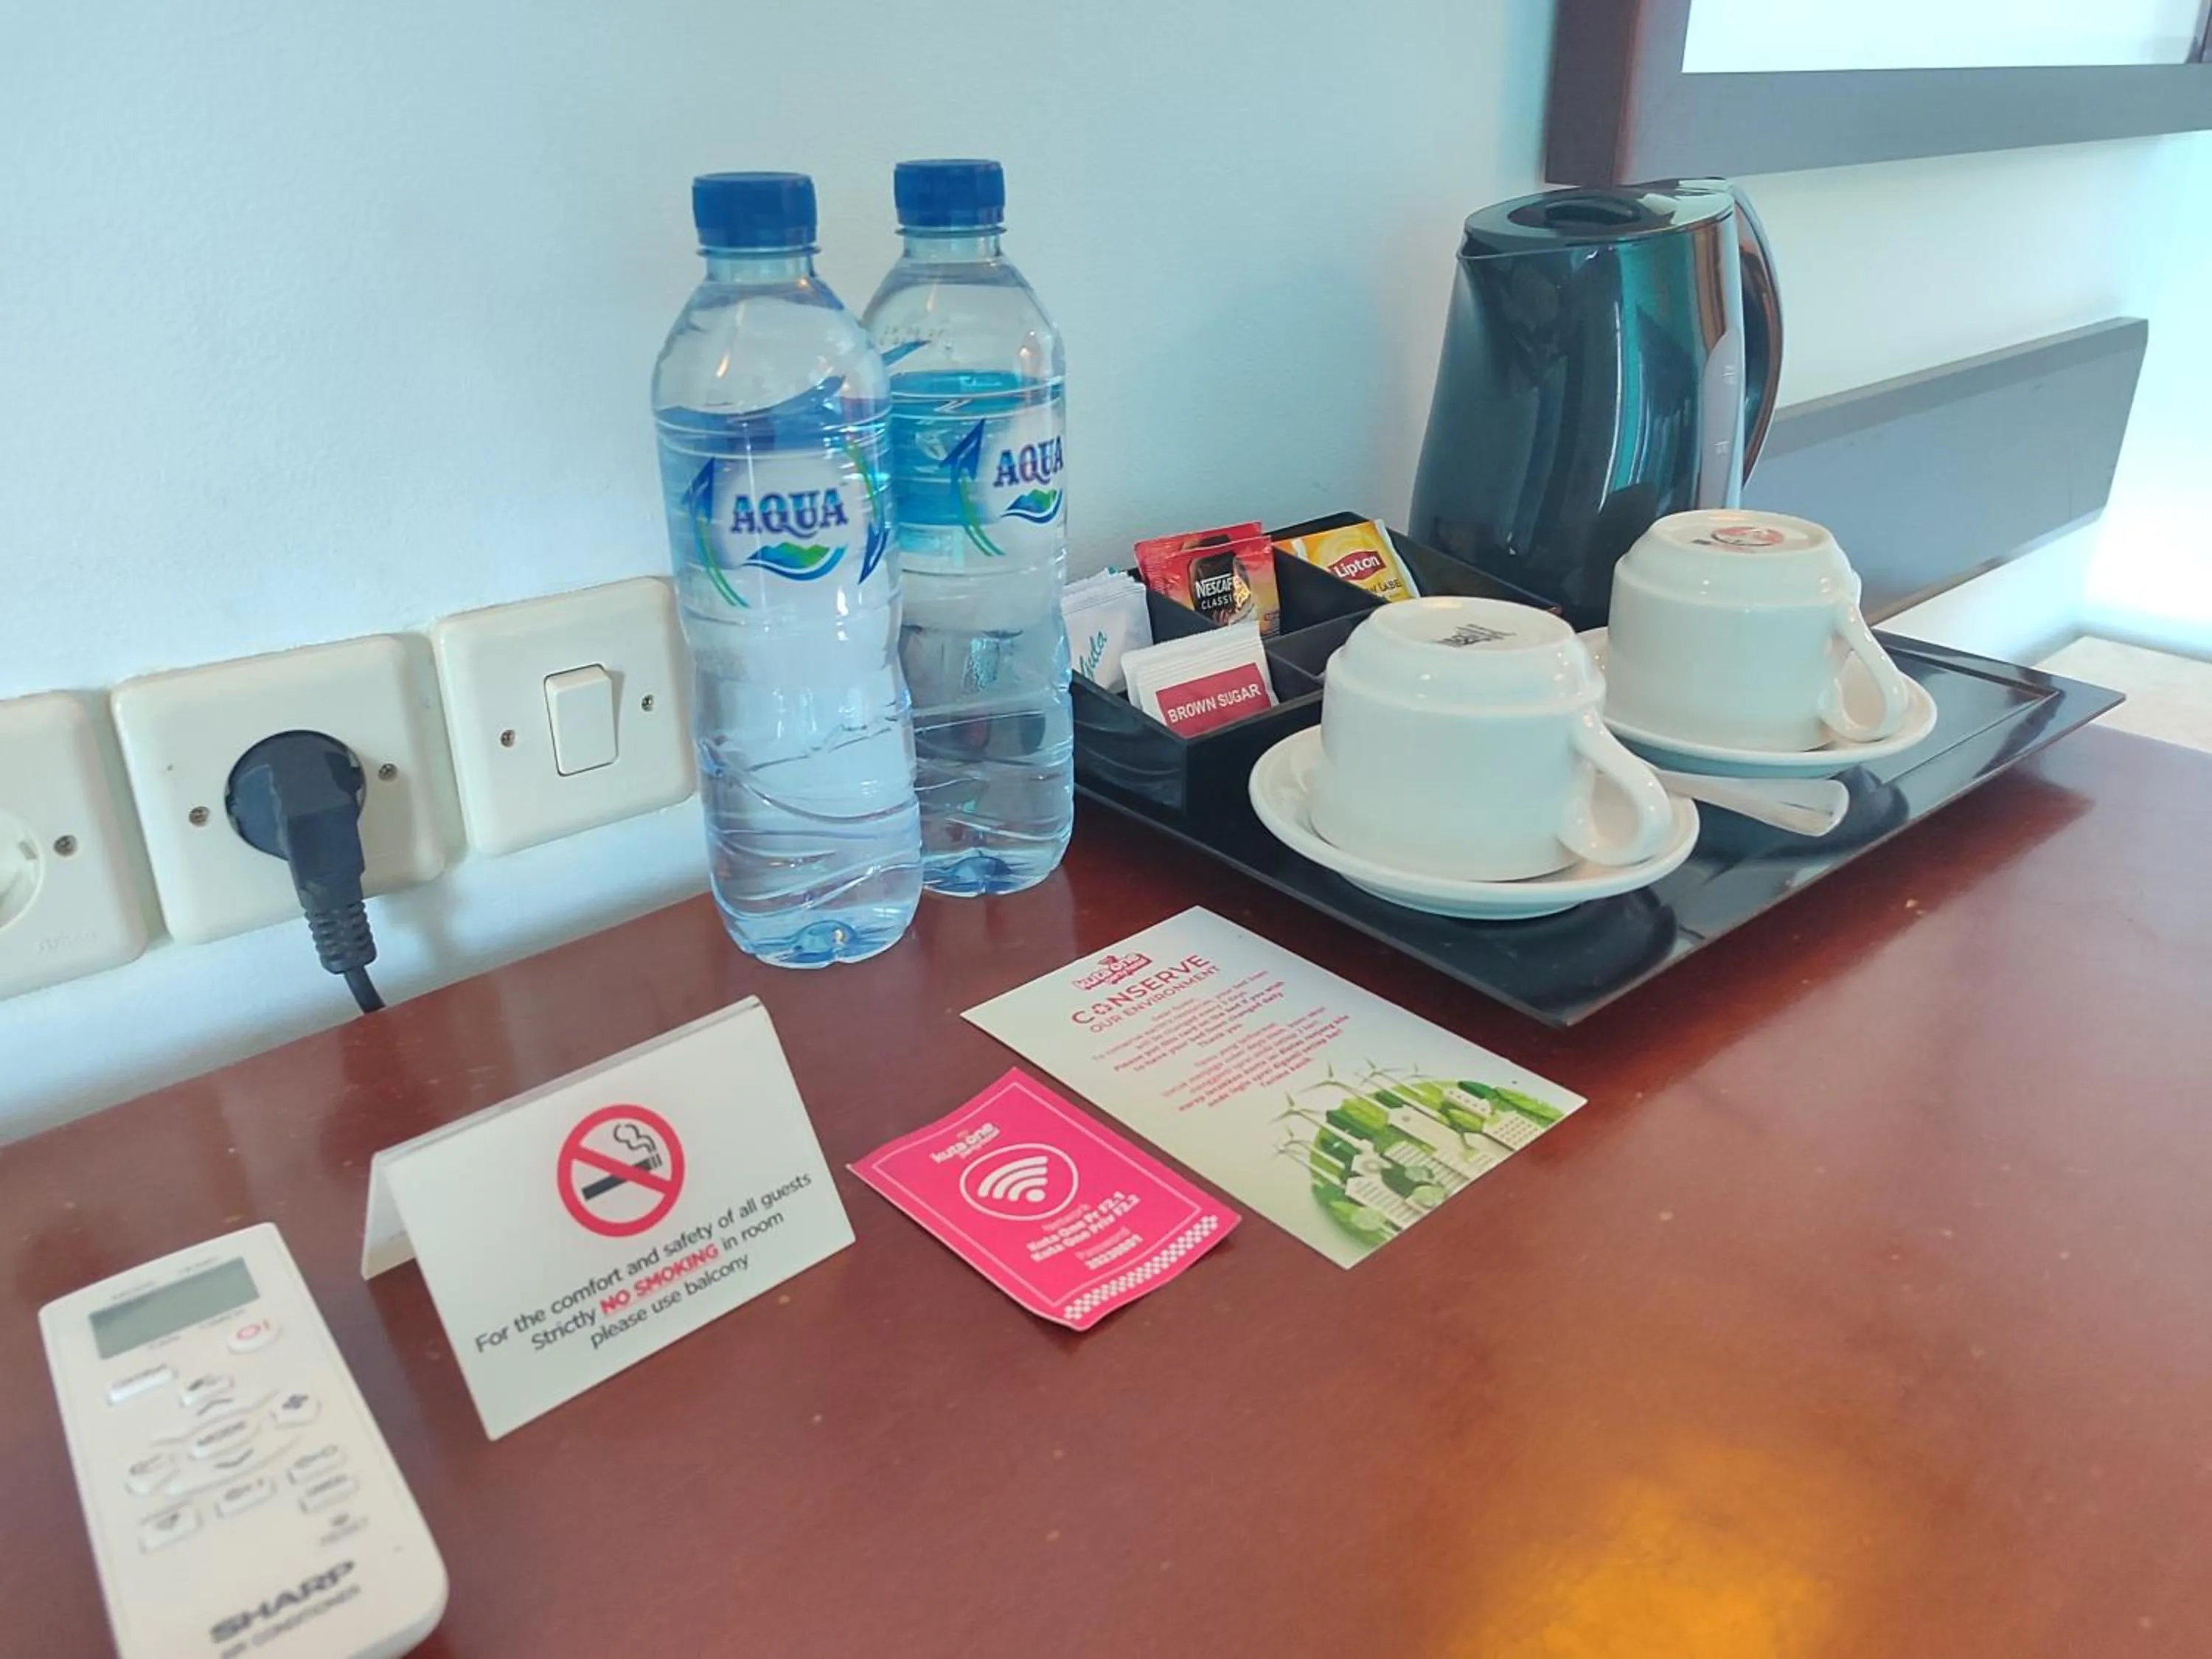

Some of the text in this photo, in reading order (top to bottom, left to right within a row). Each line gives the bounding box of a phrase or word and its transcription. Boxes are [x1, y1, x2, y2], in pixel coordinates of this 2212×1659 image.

[994, 435, 1064, 487] AQUA
[730, 488, 849, 538] AQUA
[1333, 554, 1381, 579] Lipton
[1377, 578, 1403, 592] LABE
[1201, 593, 1237, 610] CLASSI
[1167, 684, 1262, 723] BROWN SUGAR
[1072, 955, 1210, 1024] CONSERVE
[1090, 1014, 1122, 1033] OUR
[1122, 965, 1220, 1017] ENVIRONMENT
[474, 1172, 812, 1352] For the comfort and safety of all guests
[531, 1211, 785, 1351] Strictly NO SMOKING in room
[590, 1253, 750, 1349] please use balcony
[209, 1560, 355, 1644] SHARP
